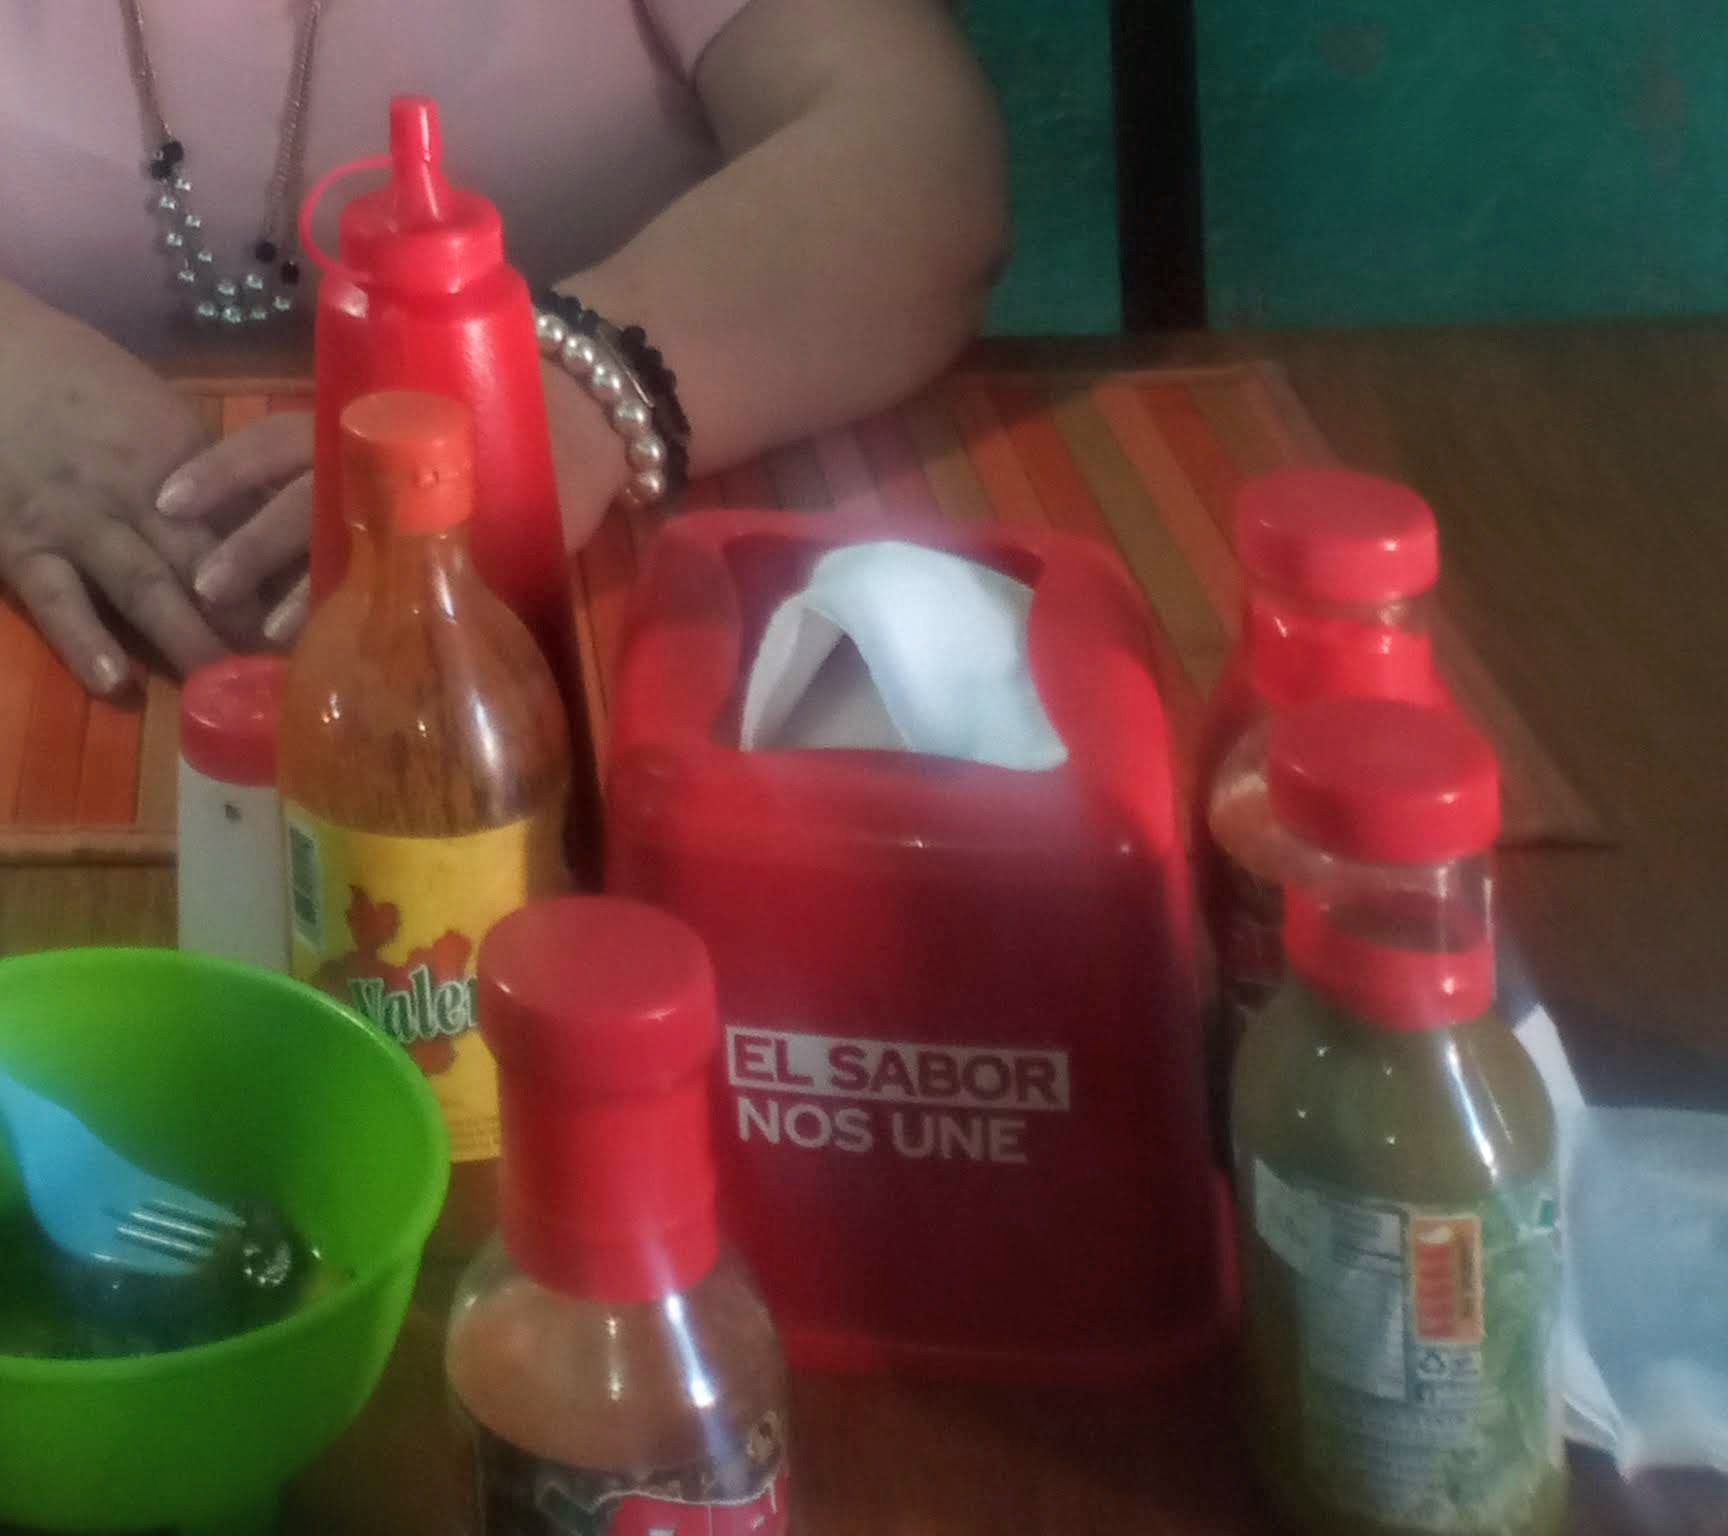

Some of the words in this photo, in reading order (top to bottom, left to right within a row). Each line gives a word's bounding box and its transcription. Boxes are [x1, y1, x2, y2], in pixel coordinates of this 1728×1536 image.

[734, 1033, 814, 1087] EL
[828, 1045, 1060, 1103] SABOR
[737, 1096, 874, 1153] NOS
[892, 1110, 1028, 1164] UNE
